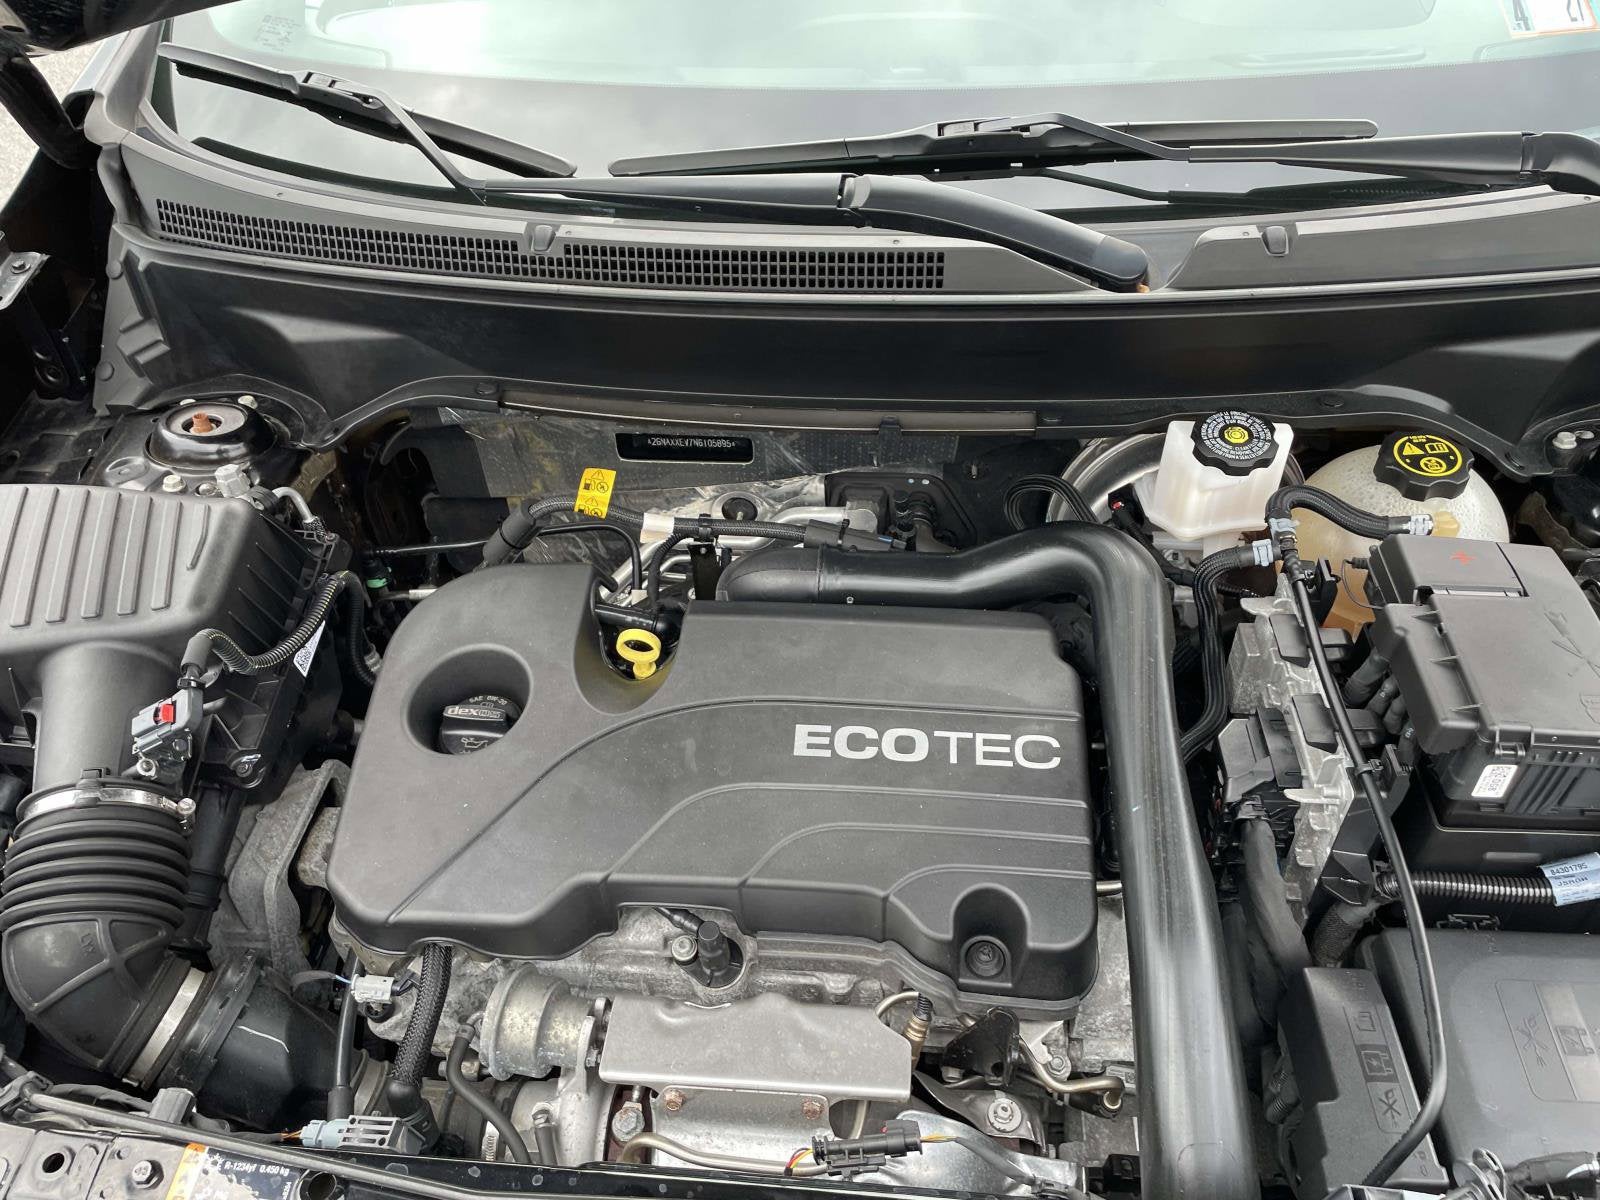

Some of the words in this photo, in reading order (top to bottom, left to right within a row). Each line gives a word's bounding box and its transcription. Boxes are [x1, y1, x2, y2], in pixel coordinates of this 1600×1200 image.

[469, 695, 483, 703] SAE
[793, 724, 1061, 769] ECOTEC
[279, 1166, 290, 1177] kg
